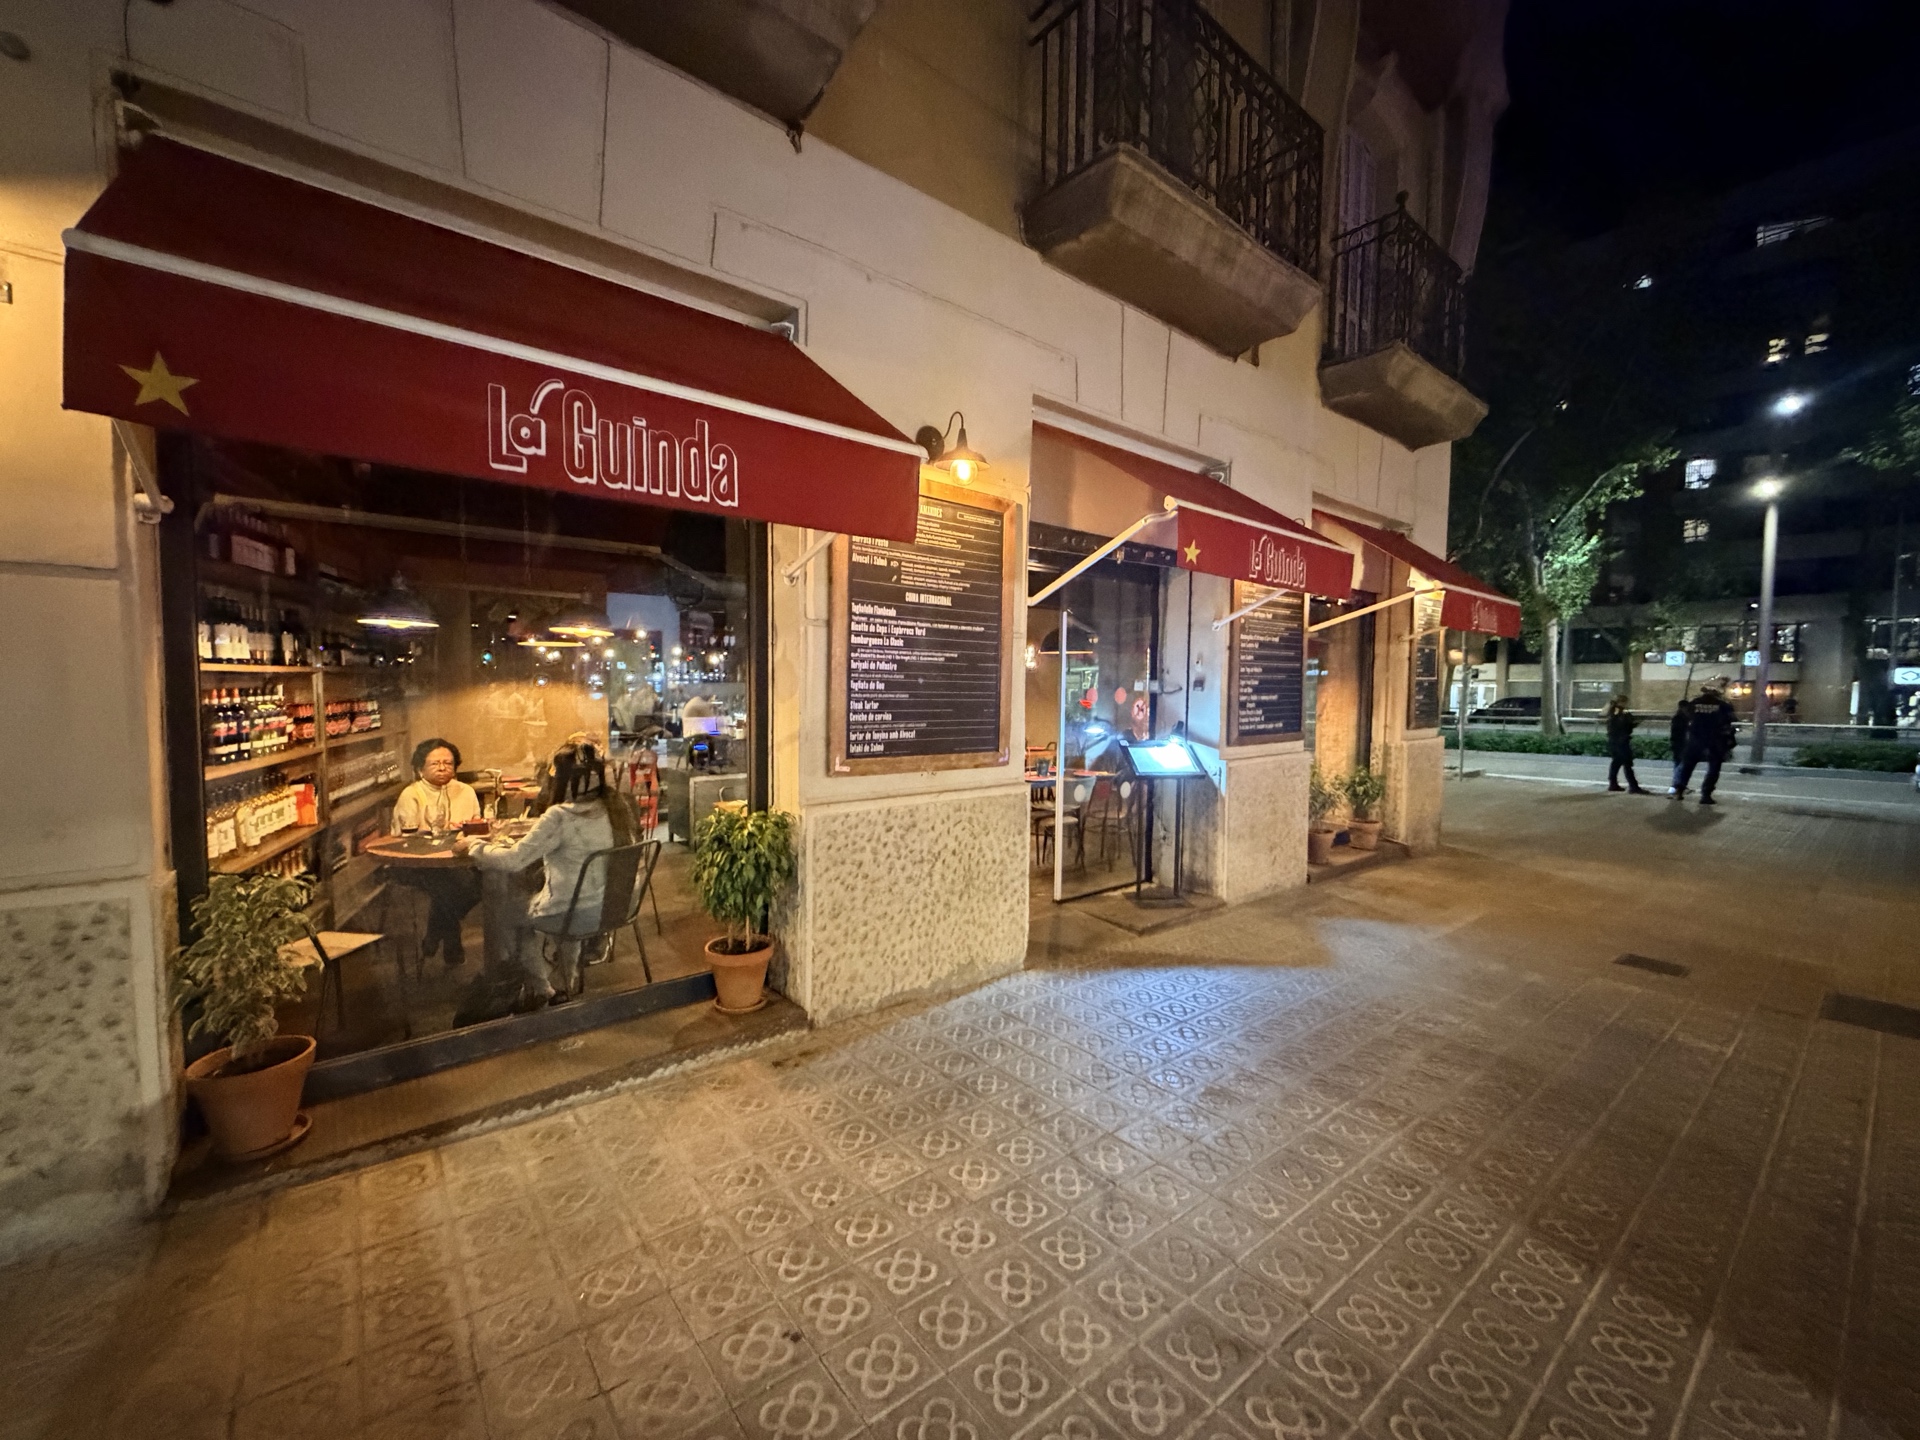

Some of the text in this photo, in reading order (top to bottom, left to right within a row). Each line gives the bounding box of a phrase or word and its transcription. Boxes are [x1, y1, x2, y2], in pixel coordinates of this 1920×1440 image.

[562, 389, 738, 507] Guinda
[1264, 537, 1306, 589] Guinda
[850, 712, 867, 721] Ceviche
[868, 712, 874, 721] de
[865, 731, 871, 740] de
